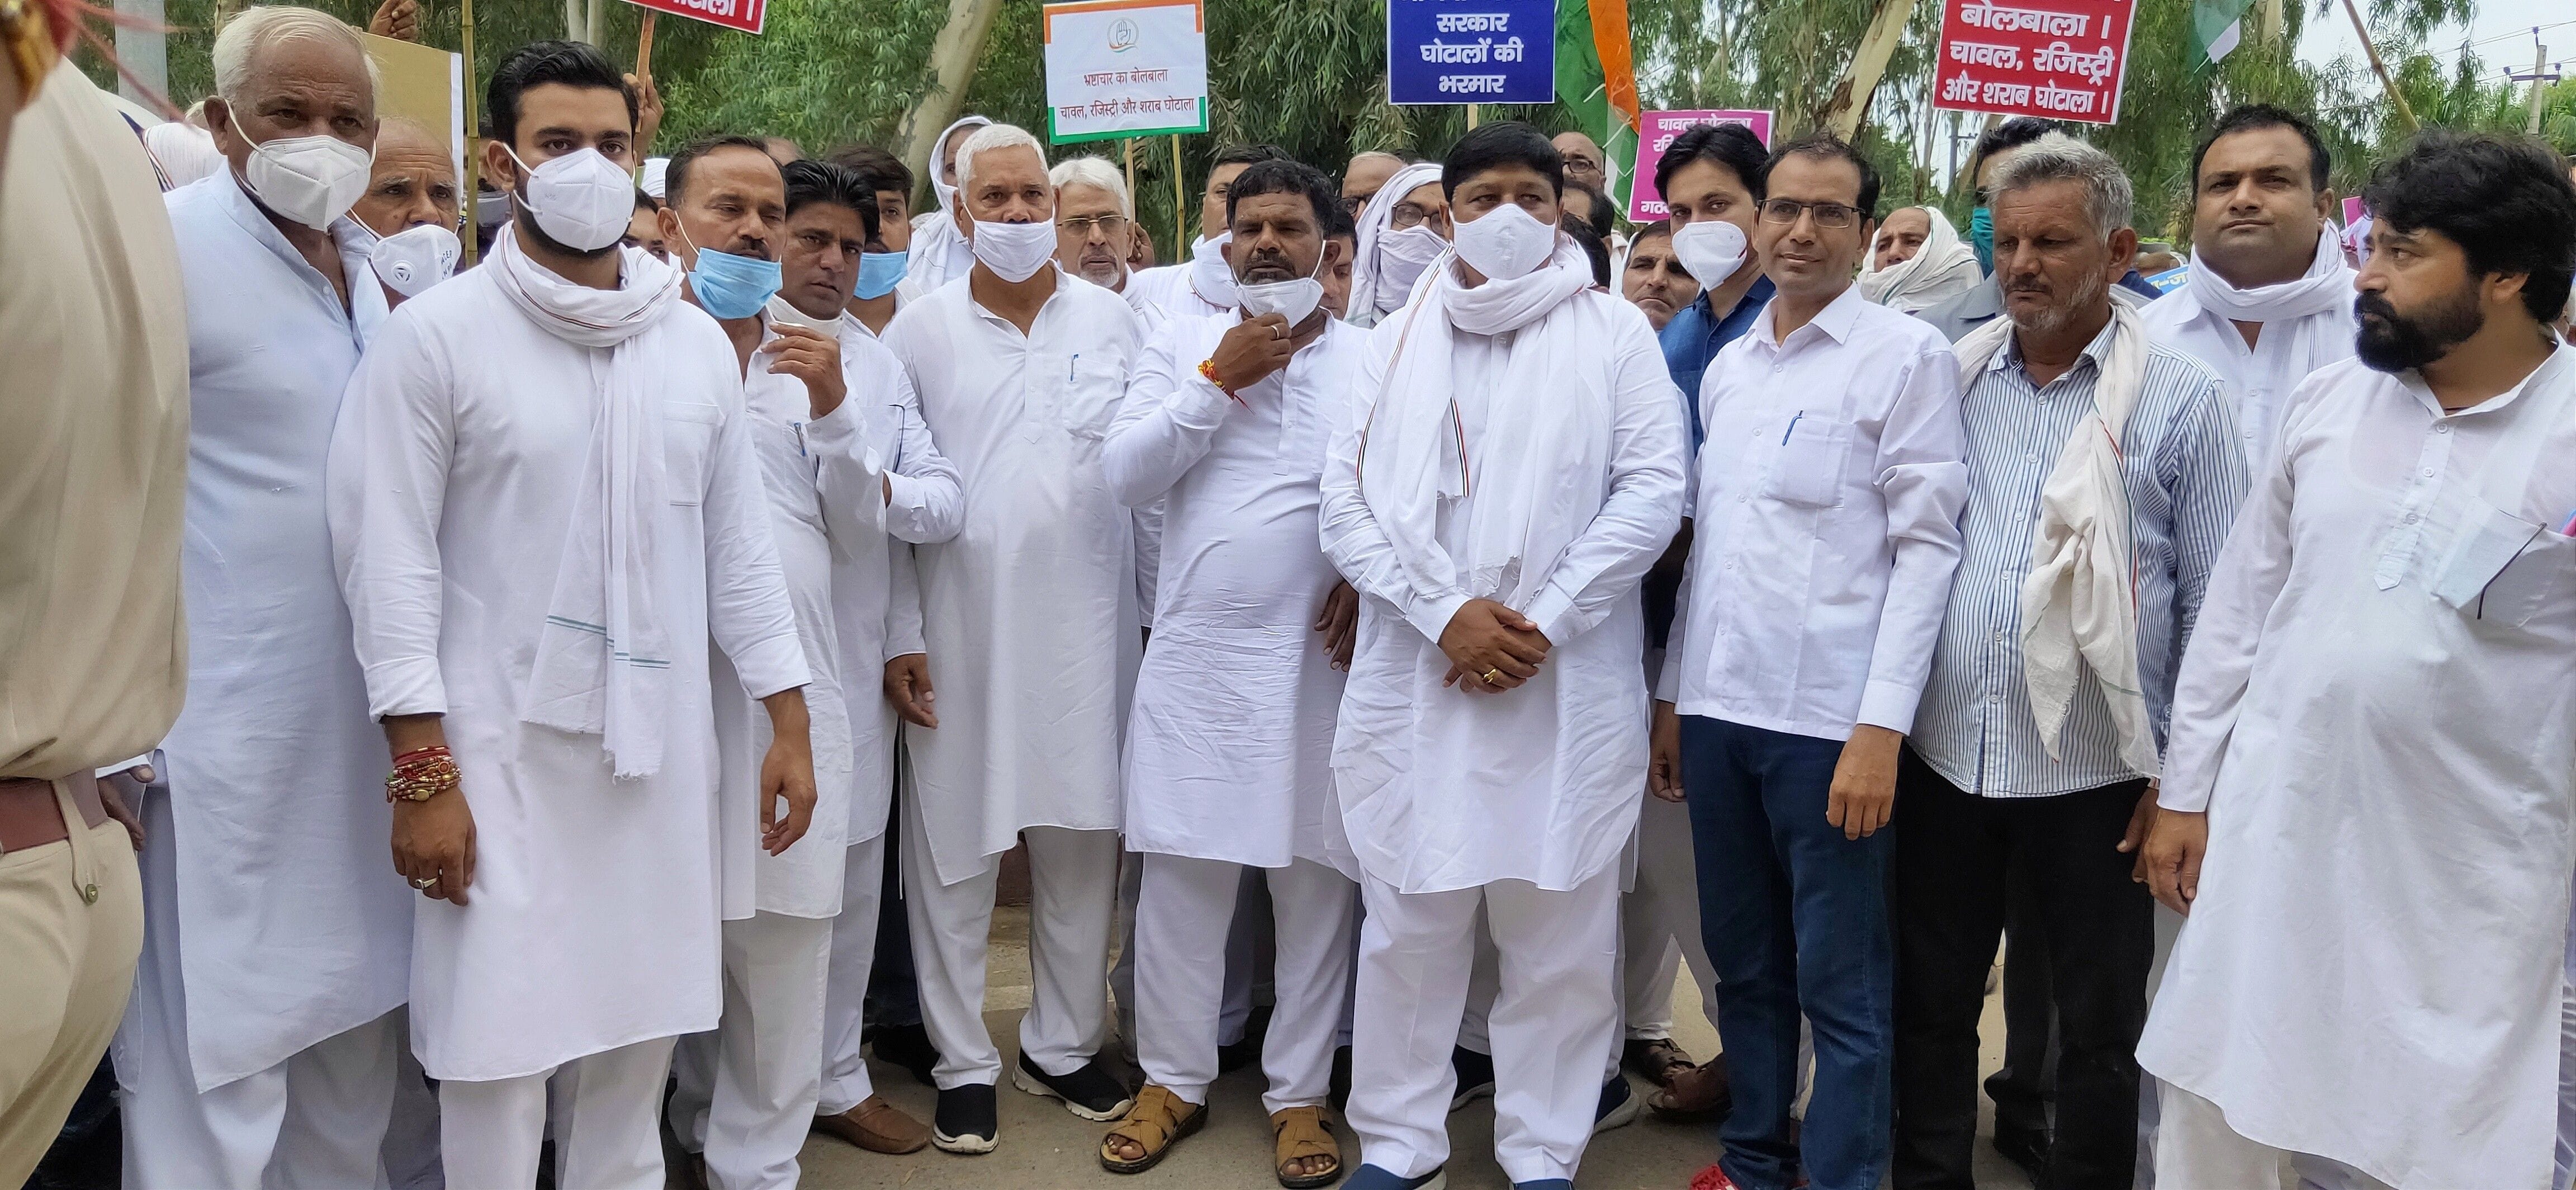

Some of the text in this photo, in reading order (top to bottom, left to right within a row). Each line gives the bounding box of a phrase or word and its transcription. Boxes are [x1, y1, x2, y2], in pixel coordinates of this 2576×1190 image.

[1436, 13, 1510, 32] सरकार
[1961, 0, 2090, 37] बोलबाला
[1420, 36, 1524, 64] घोटालों की
[1083, 66, 1168, 86] भ्रष्टाचार का बोलबाला
[1950, 41, 2115, 87] चावल, रजिस्ट्री
[1438, 74, 1506, 93] भरमार
[1942, 70, 1981, 102] और
[1982, 82, 2031, 107] शराब
[2035, 79, 2095, 113] घोटाला
[1060, 95, 1194, 119] चावल, रजिस्ट्री और शराब घोटाला
